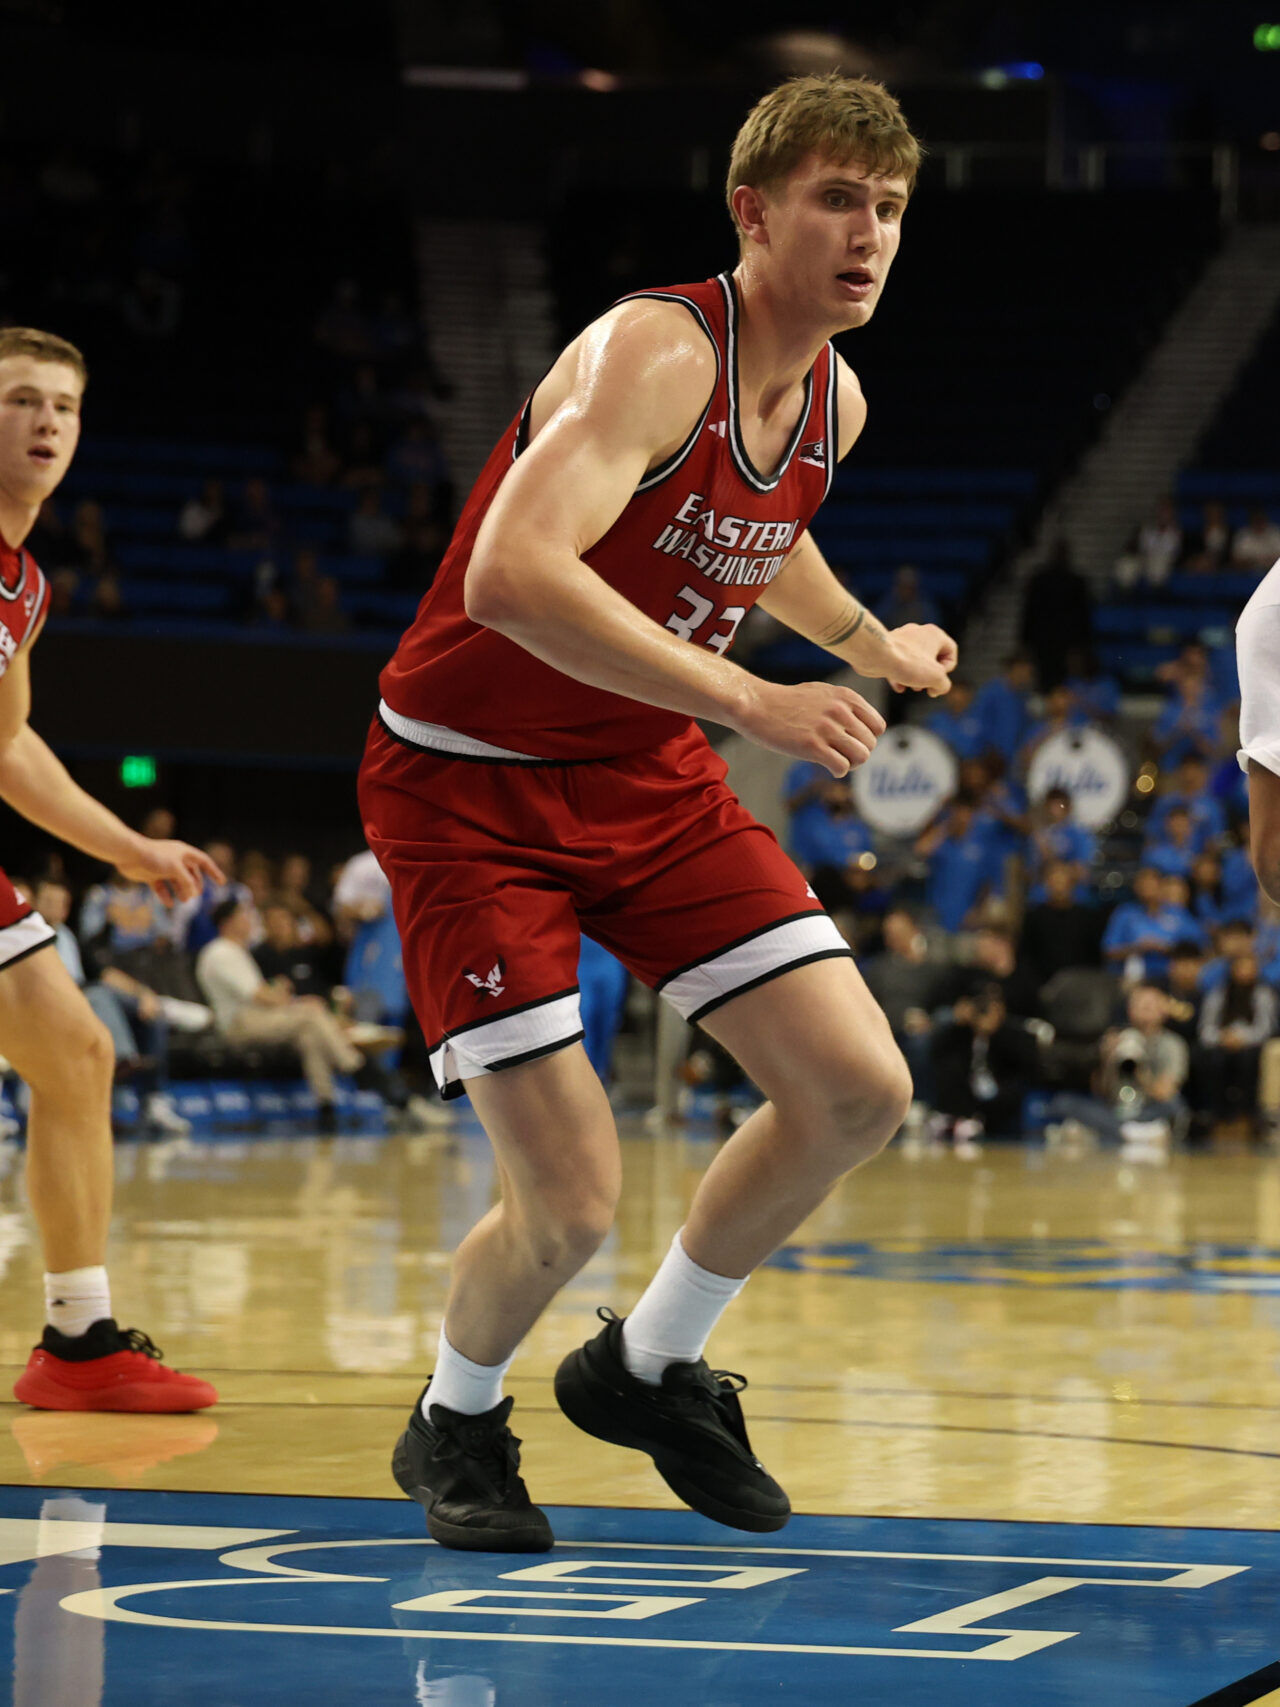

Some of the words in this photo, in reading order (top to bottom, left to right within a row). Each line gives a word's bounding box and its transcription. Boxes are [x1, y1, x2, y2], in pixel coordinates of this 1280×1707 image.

[673, 492, 800, 552] EASTERN
[652, 524, 787, 586] WASHINGTO
[664, 584, 746, 656] 33
